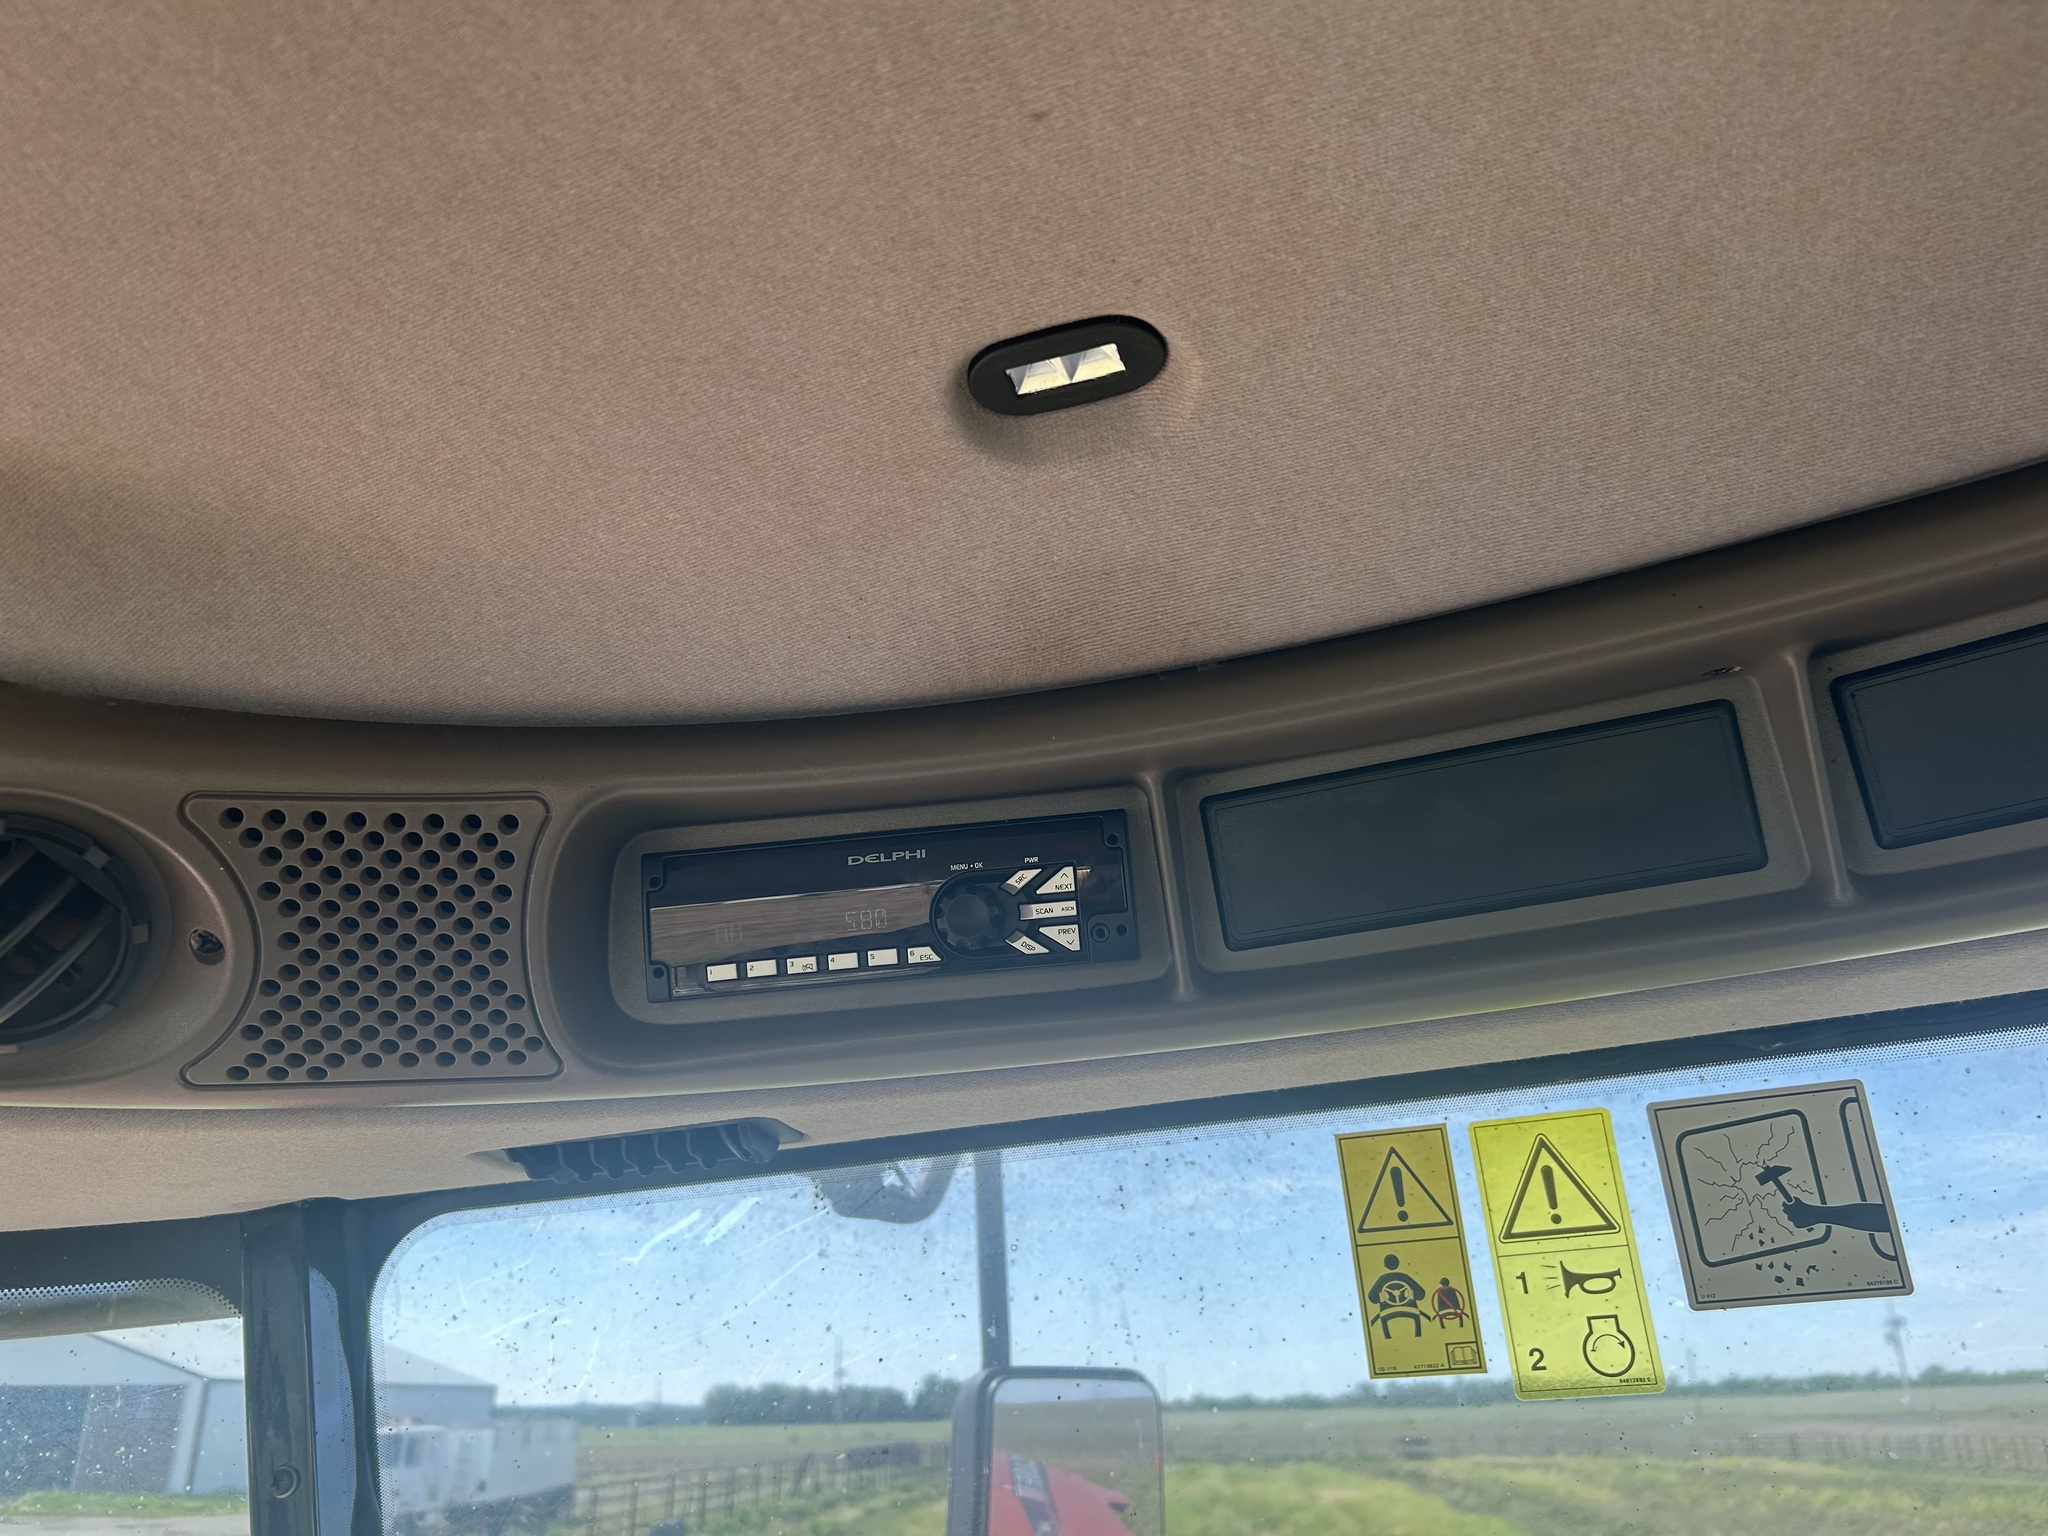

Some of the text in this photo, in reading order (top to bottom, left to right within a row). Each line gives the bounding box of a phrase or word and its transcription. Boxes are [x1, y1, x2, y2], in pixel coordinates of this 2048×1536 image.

[847, 849, 926, 866] DELPHI
[1024, 856, 1039, 864] PWR
[950, 861, 984, 871] MENU OK
[1015, 873, 1028, 886] SRC
[1054, 883, 1073, 891] NEXT
[1035, 907, 1054, 915] SCAN
[1057, 927, 1077, 936] PREV
[1020, 941, 1036, 952] DISP
[1515, 1271, 1529, 1295] 1
[1528, 1347, 1548, 1371] 2
